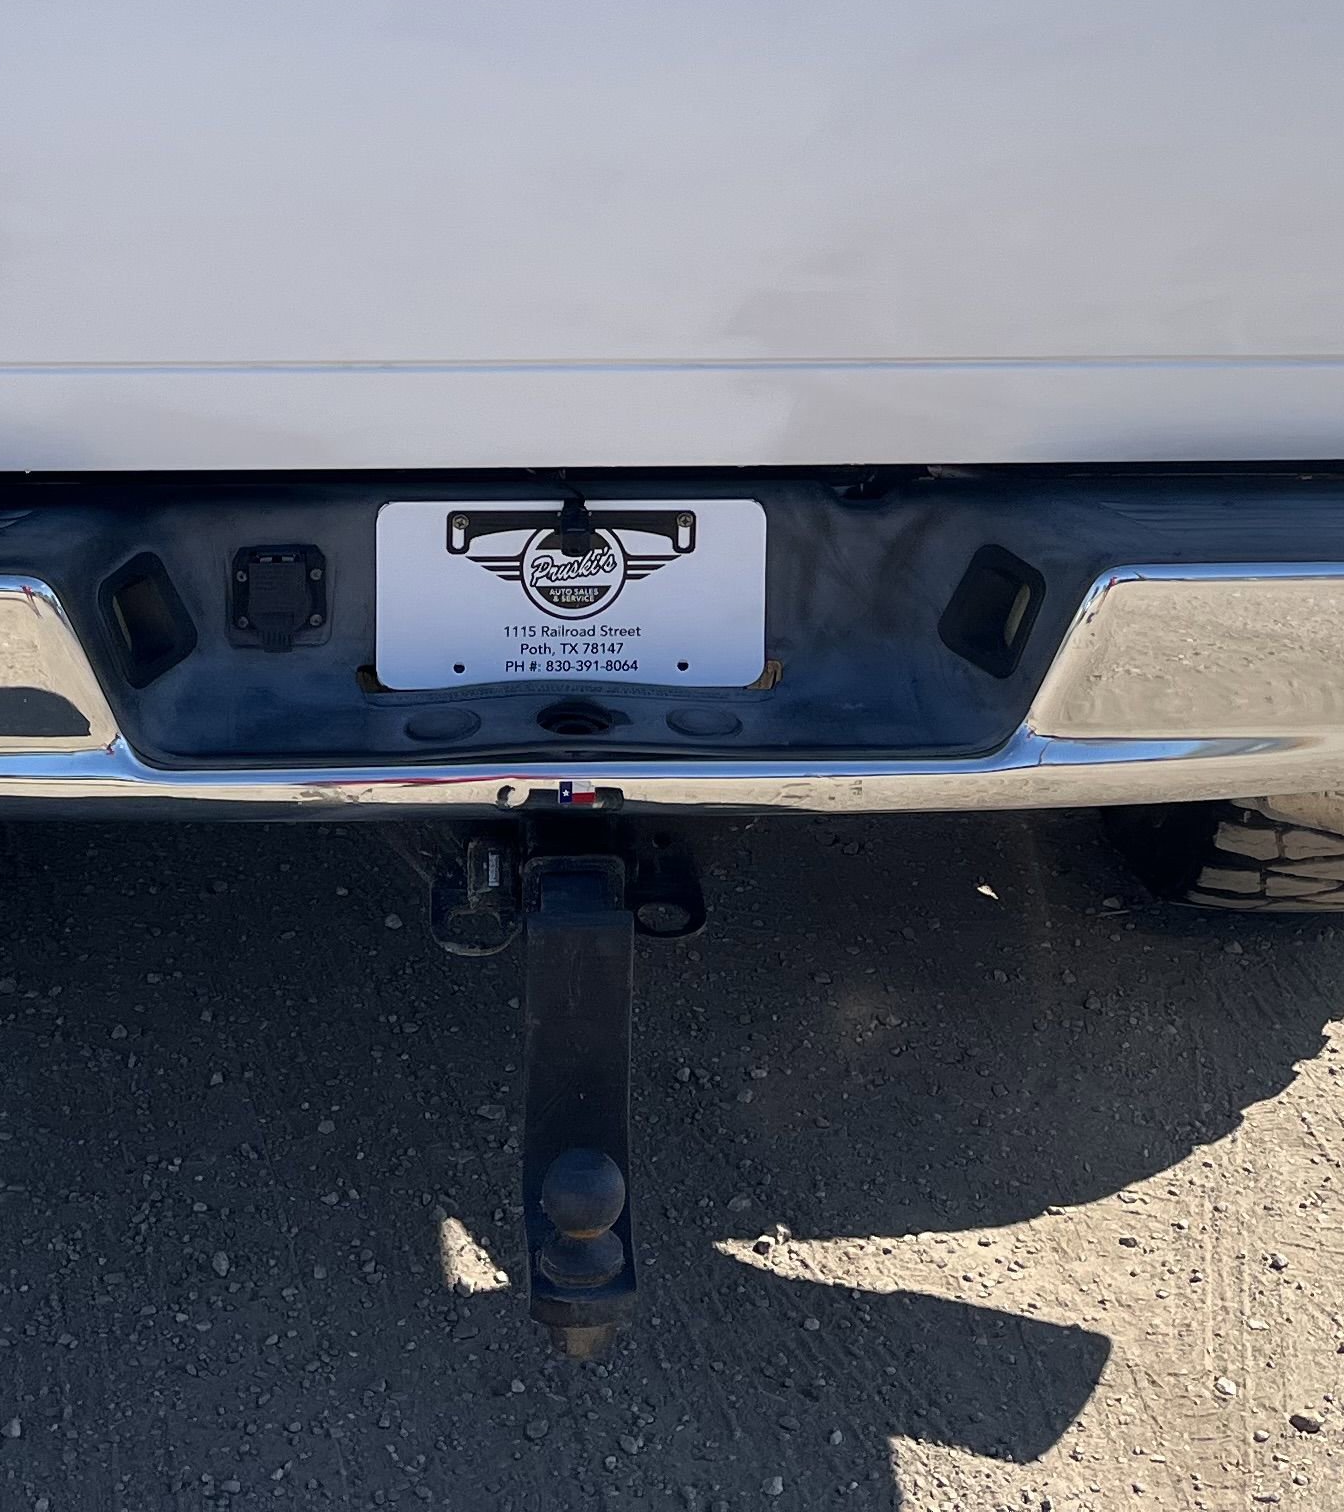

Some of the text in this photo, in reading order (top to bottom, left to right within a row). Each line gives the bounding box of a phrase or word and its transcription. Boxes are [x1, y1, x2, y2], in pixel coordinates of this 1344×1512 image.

[529, 546, 618, 588] Pruski's
[548, 588, 599, 596] AUTO SALES
[561, 595, 595, 603] SERVICE
[503, 624, 642, 638] 1115 Railroad Street
[520, 642, 624, 657] Poth, TX 78147
[505, 659, 639, 673] PH #: 830-391-8064
